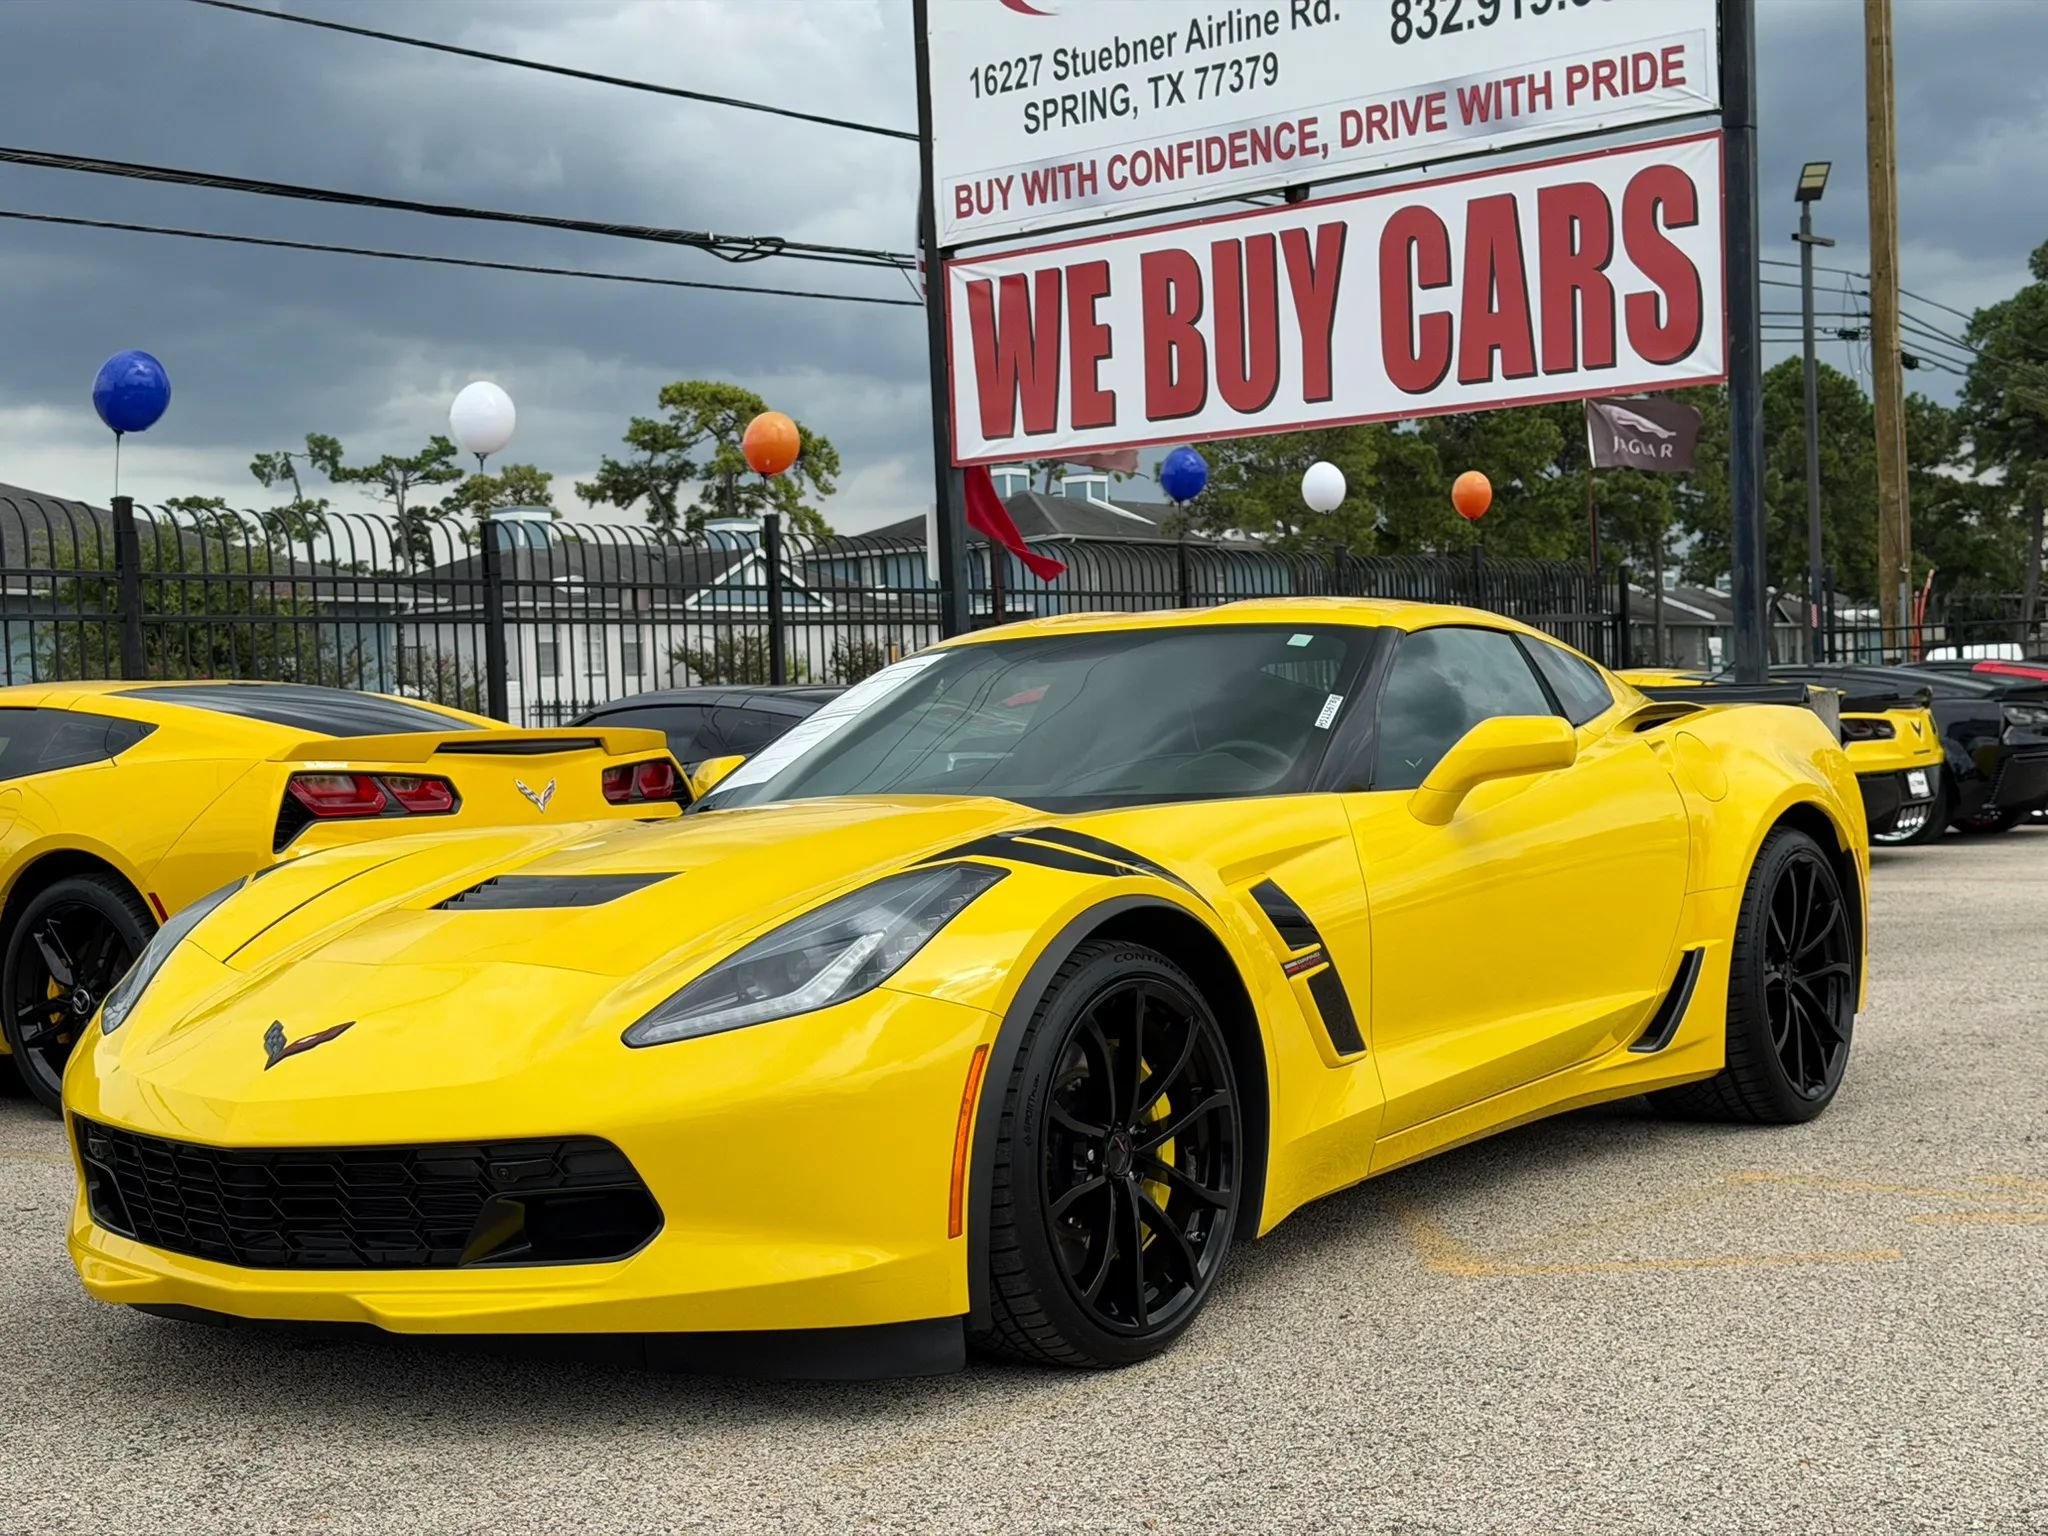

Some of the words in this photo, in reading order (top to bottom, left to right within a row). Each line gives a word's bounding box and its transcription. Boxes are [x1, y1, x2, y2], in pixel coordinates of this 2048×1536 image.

[969, 54, 1043, 98] 16227
[1053, 31, 1178, 81] Stuebner
[1185, 7, 1280, 54] Airline
[1290, 0, 1341, 30] Rd.
[1390, 0, 1616, 44] 832.9.
[955, 174, 1014, 219] BUY
[1022, 159, 1098, 206] WITH
[1107, 116, 1329, 192] CONFIDENCE,
[1340, 91, 1447, 149] DRIVE
[1457, 70, 1552, 126] WITH
[1566, 45, 1687, 106] PRIDE
[1024, 82, 1138, 135] SPRING,
[1147, 70, 1186, 109] TX
[1194, 51, 1279, 100] 77379
[965, 259, 1117, 441] WE
[1140, 221, 1347, 422] BUY
[1379, 164, 1704, 396] CARS
[1613, 435, 1673, 458] JAGUAR
